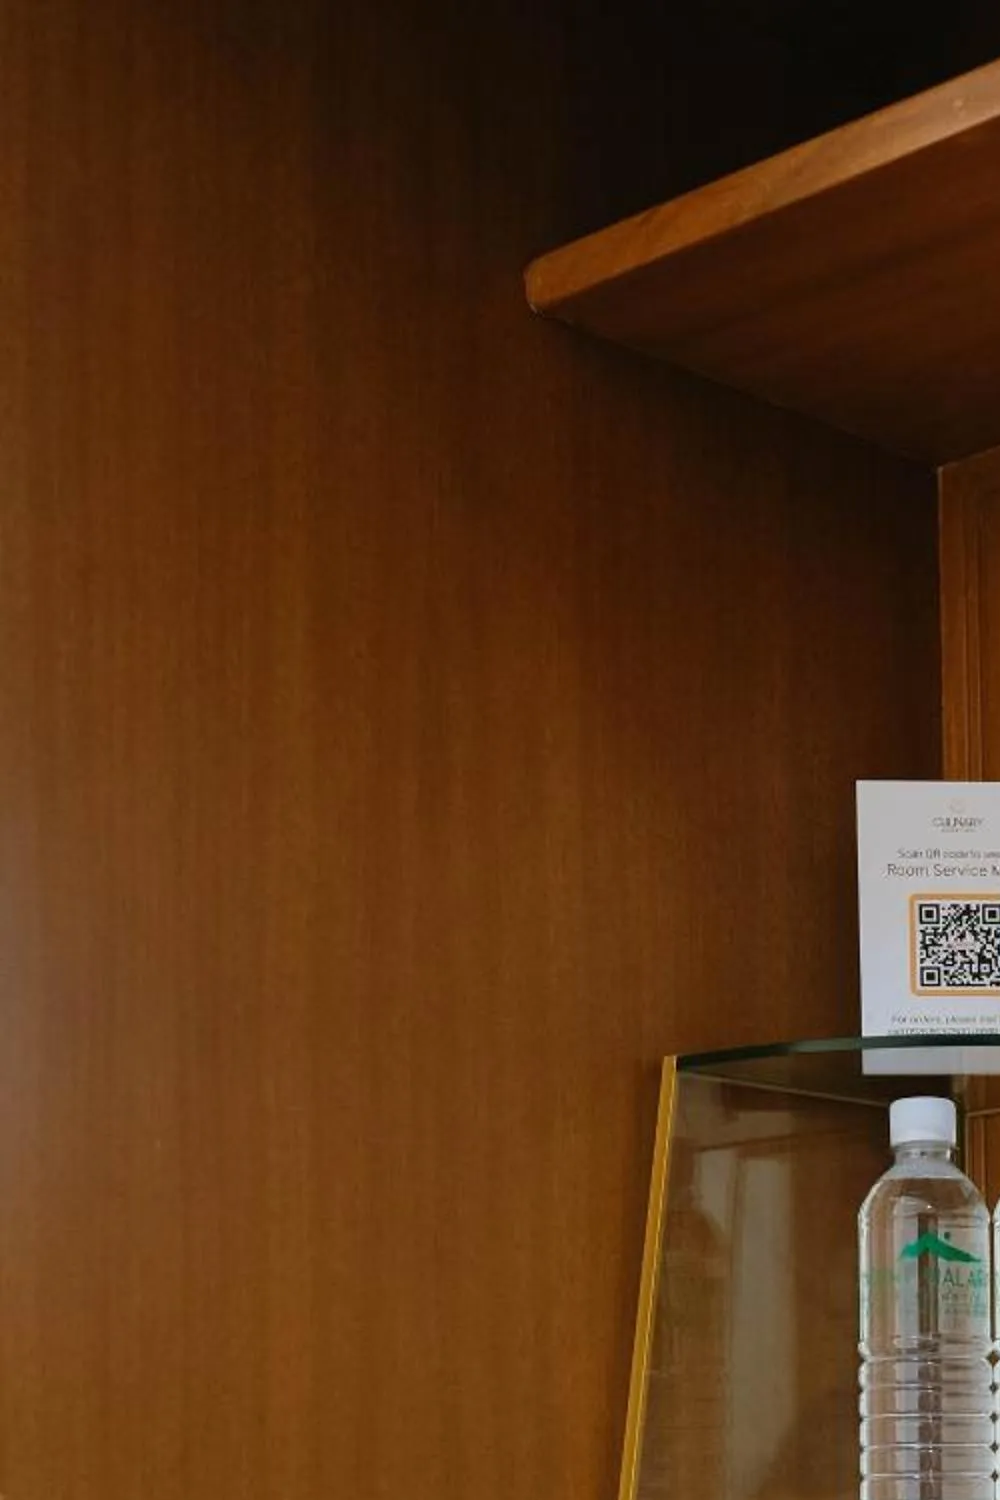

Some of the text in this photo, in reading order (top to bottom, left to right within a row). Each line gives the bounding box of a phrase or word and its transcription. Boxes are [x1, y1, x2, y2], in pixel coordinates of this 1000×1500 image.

[897, 848, 922, 859] Scan
[925, 848, 941, 860] QR
[887, 863, 929, 877] Room
[933, 863, 987, 877] Service
